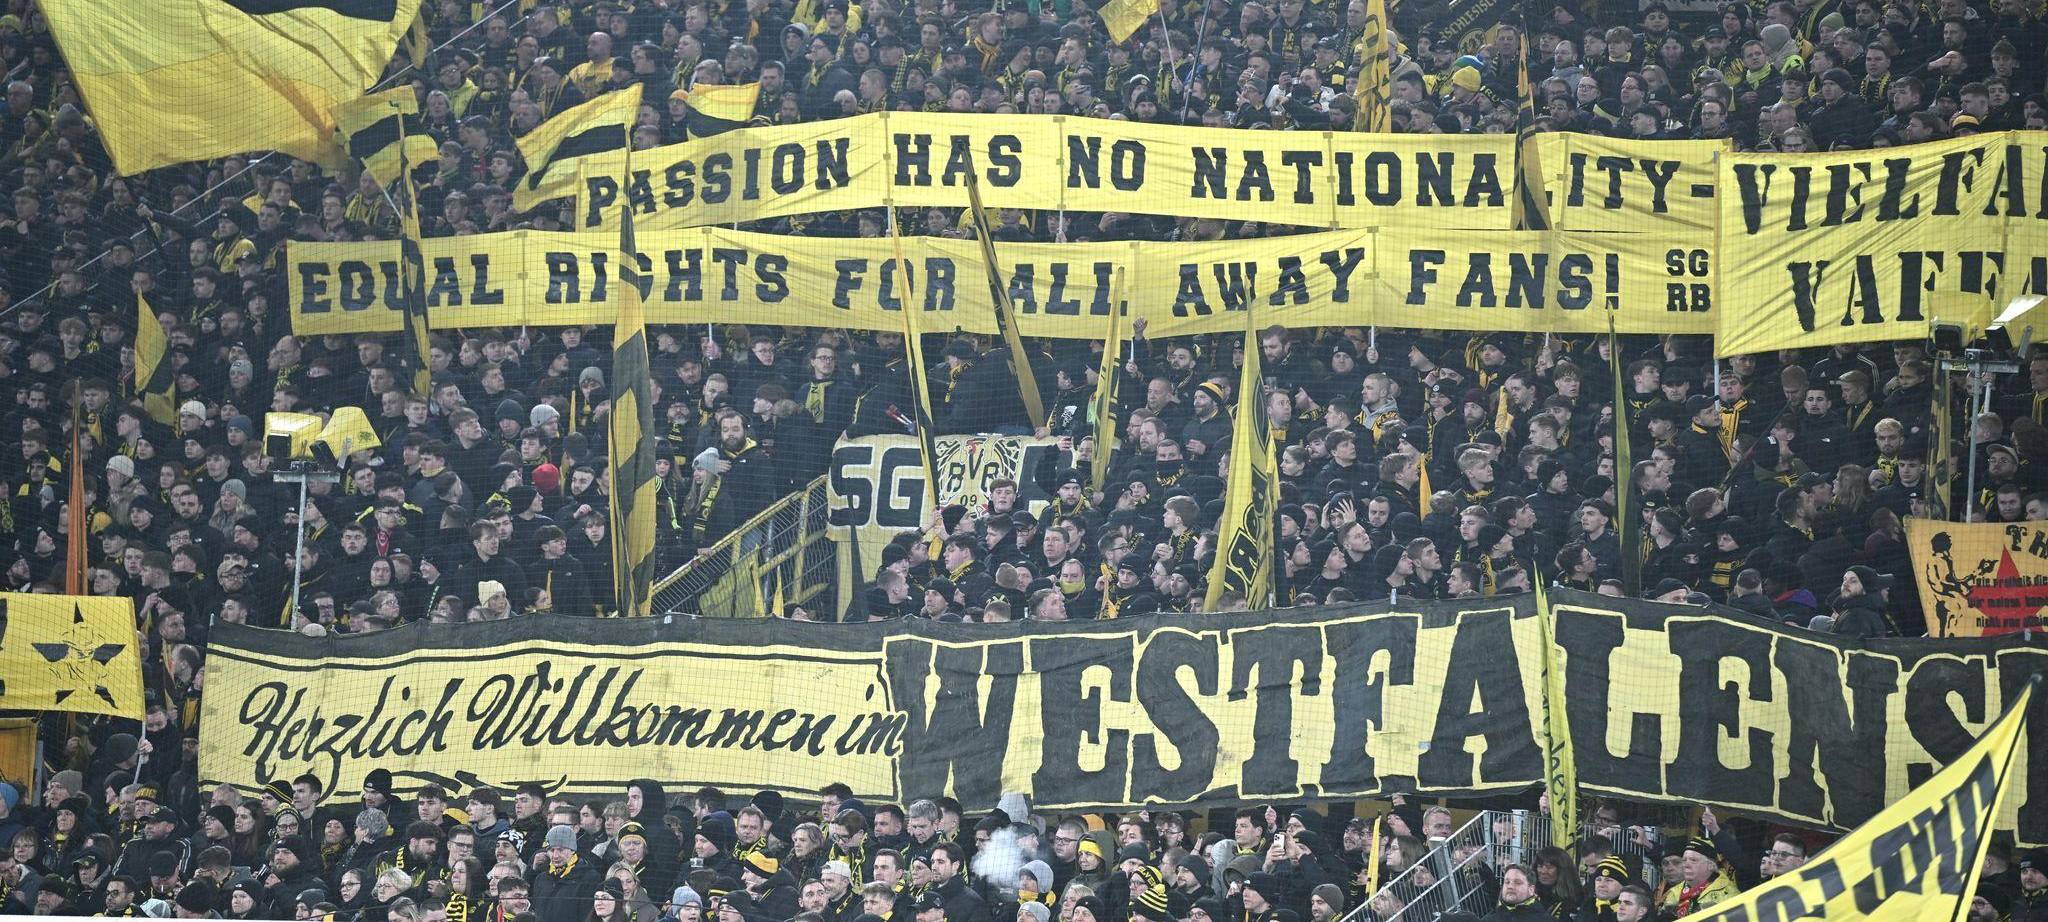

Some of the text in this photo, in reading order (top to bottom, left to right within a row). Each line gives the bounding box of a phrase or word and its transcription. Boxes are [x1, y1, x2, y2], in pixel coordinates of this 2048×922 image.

[586, 133, 1715, 228] PASSION HAS NO NATIONAITY-
[832, 257, 956, 309] FOR
[1007, 261, 1128, 316] ALL
[1172, 247, 1365, 317] AWAY
[1406, 249, 1619, 310] FANS!
[1665, 248, 1709, 277] SG
[1666, 283, 1711, 312] RB
[829, 445, 926, 527] SG
[238, 674, 464, 798] Herzlich
[467, 660, 830, 757] Willkommen
[835, 682, 907, 757] im
